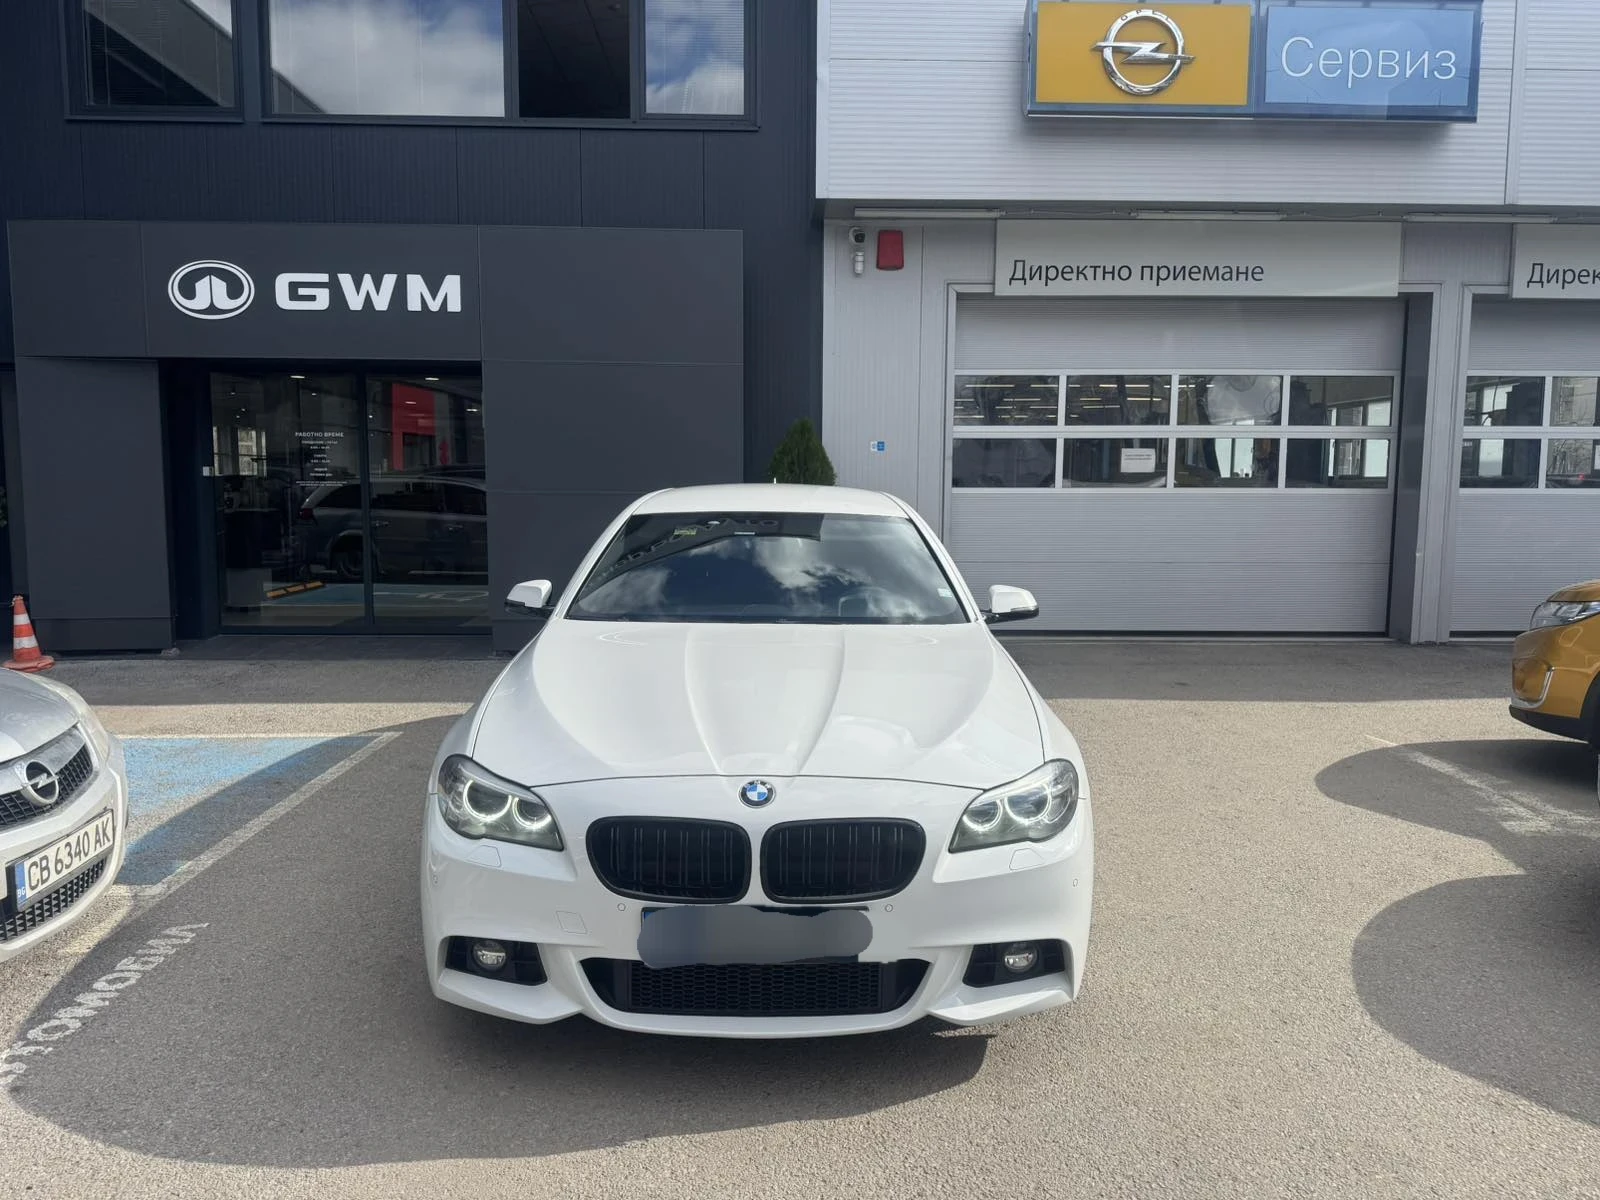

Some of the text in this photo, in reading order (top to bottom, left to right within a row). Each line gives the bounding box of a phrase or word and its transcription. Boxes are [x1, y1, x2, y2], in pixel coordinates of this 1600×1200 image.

[1281, 36, 1456, 89] Сервиз
[275, 272, 461, 313] GWM
[1009, 259, 1265, 287] Директно приемане
[28, 817, 111, 892] CB 6340 AK
